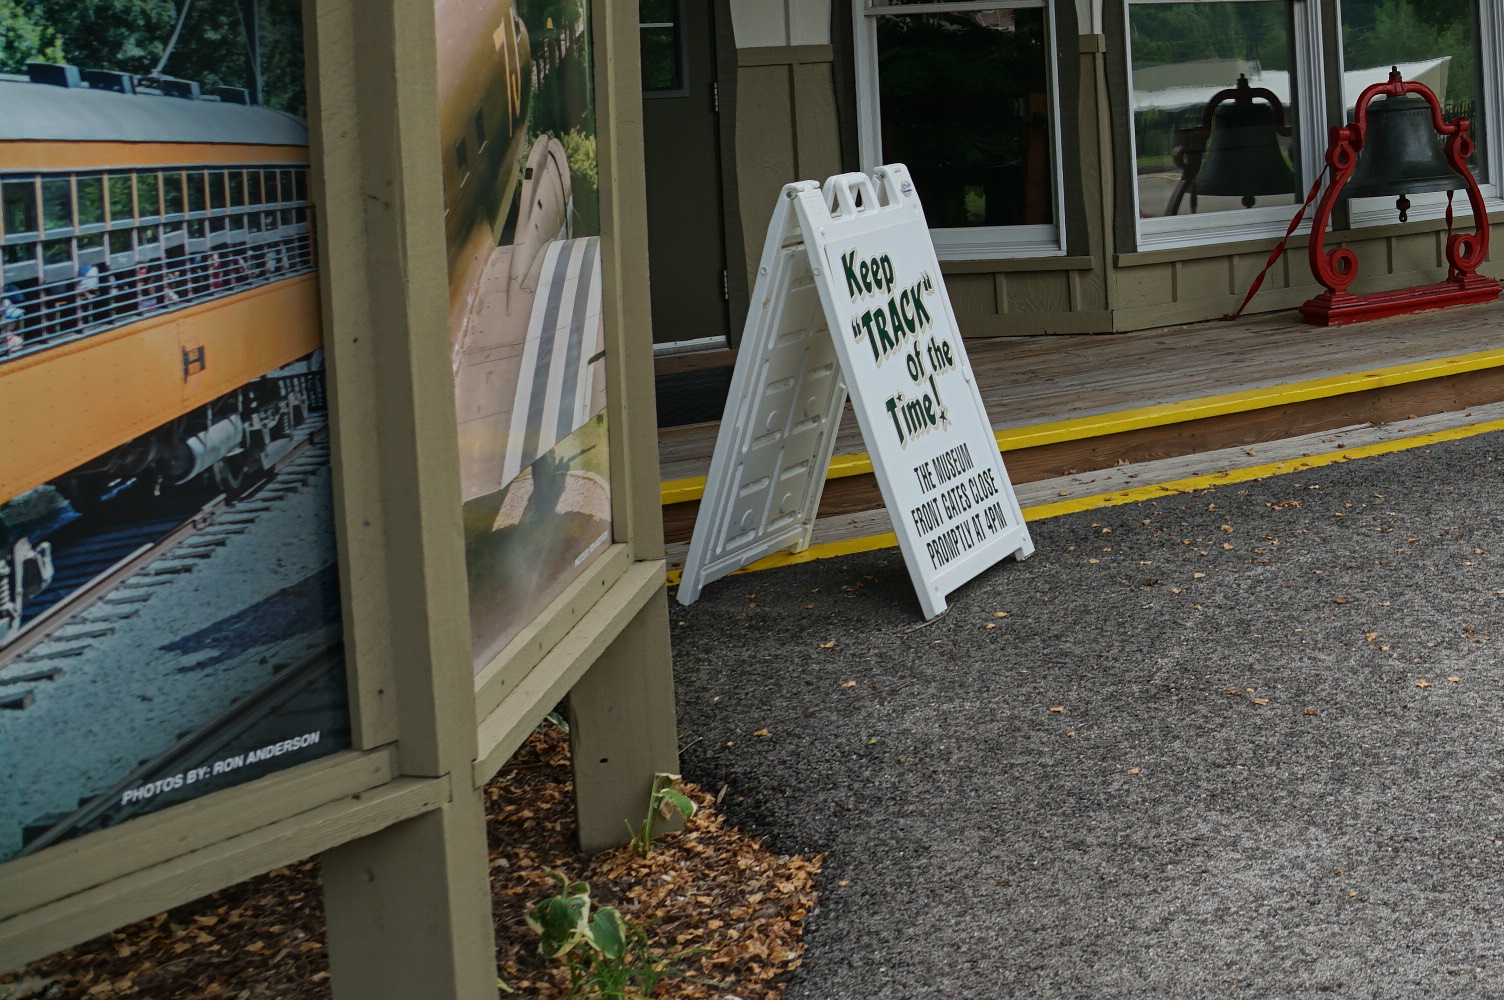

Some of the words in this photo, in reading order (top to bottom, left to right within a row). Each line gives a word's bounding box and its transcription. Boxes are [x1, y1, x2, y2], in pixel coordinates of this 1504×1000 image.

[841, 249, 895, 299] Keep
[906, 340, 924, 382] of
[927, 337, 953, 372] the
[886, 375, 945, 446] Time!
[911, 497, 944, 537] FRONT
[941, 483, 971, 520] GATES
[968, 468, 999, 504] CLOSE
[914, 462, 936, 494] THE
[932, 443, 974, 485] MUSEUM
[926, 519, 975, 570] PROMPTLY
[972, 513, 986, 543] AT
[984, 502, 1007, 534] 4PM
[121, 774, 184, 806] PHOTOS
[186, 767, 210, 785] BY:
[213, 755, 244, 775] RON
[246, 731, 320, 765] ANDERSON
